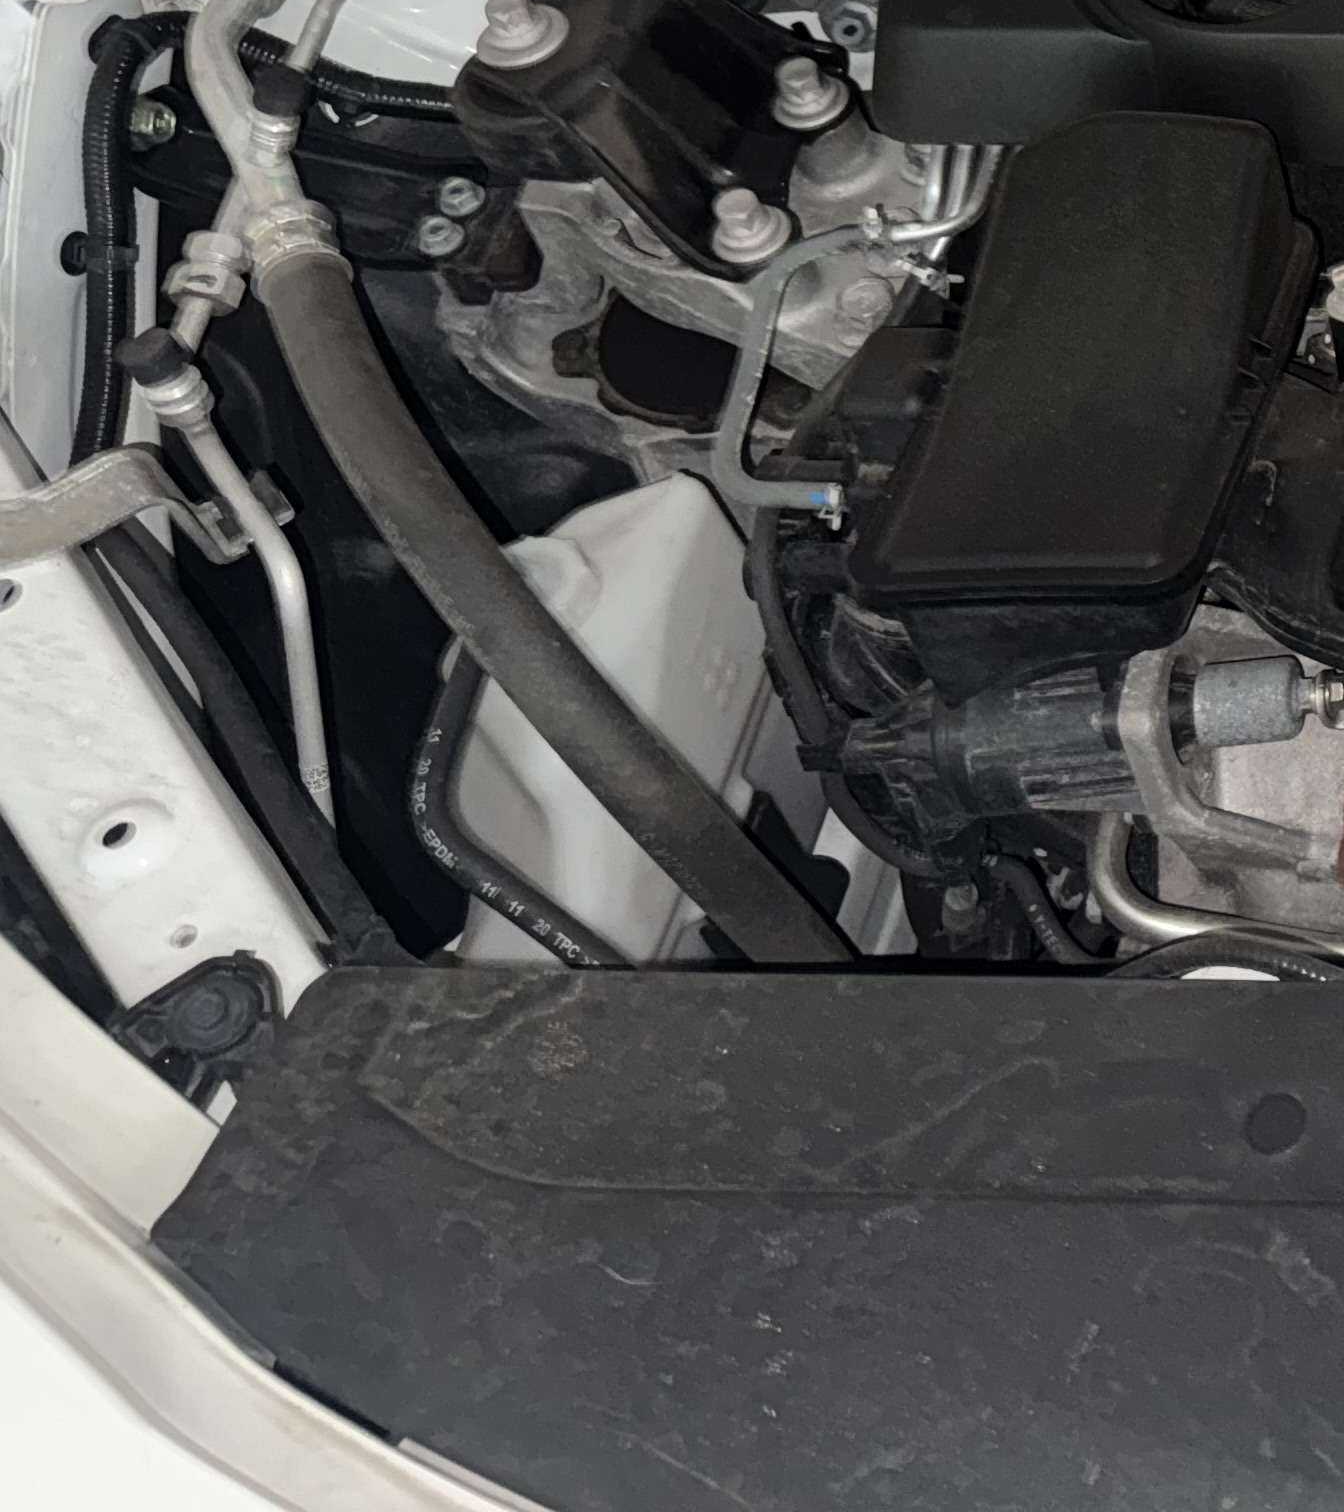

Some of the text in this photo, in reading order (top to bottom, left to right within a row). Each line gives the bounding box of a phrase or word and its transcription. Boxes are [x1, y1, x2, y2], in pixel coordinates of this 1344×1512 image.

[414, 782, 427, 815] TPC
[508, 900, 525, 917] 11
[532, 918, 551, 937] 20
[553, 932, 581, 959] TPC
